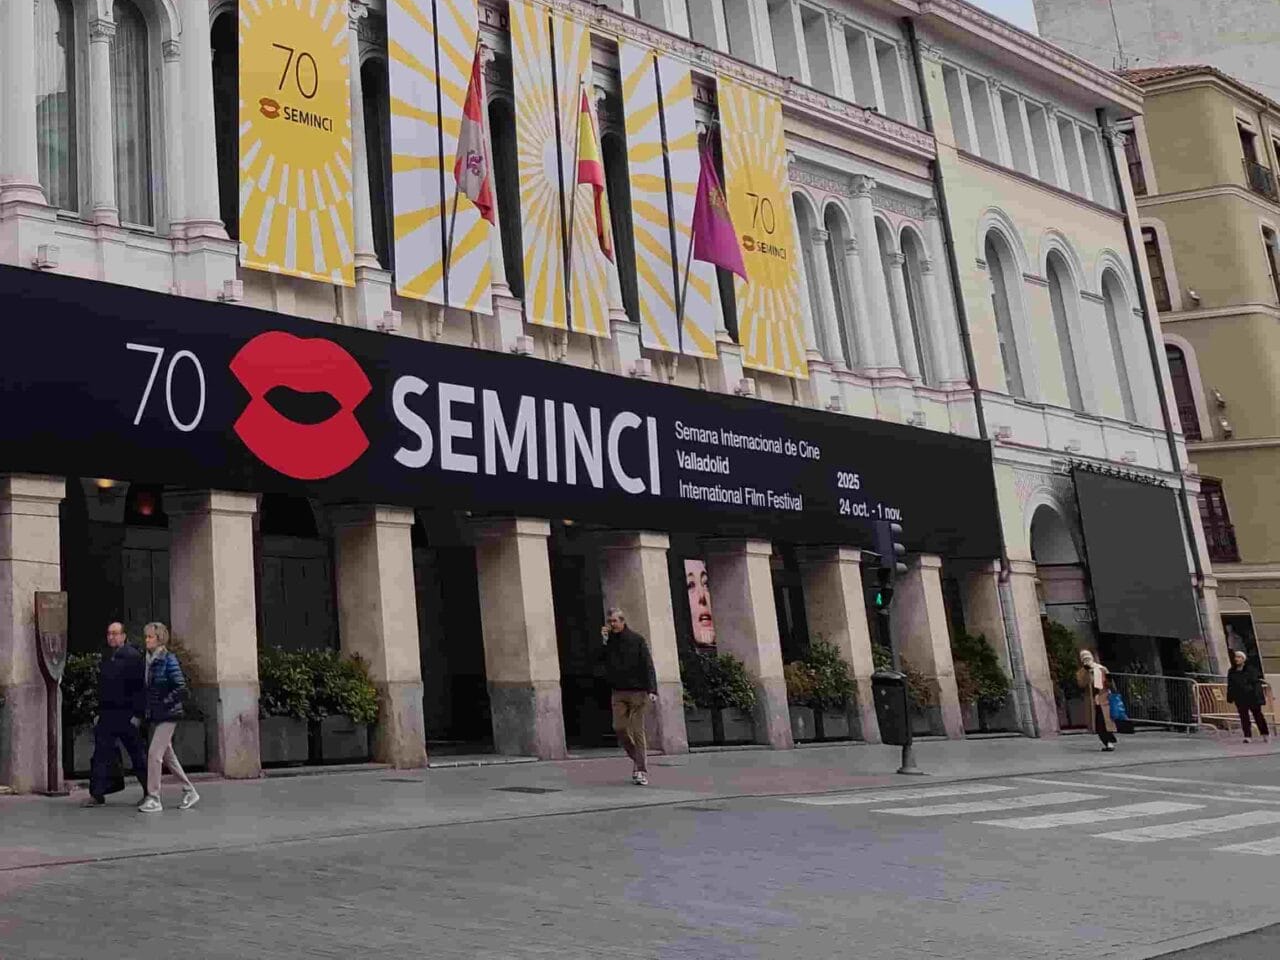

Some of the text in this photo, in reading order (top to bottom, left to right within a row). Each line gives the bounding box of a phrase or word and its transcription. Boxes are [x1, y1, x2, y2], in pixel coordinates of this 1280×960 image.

[272, 42, 318, 99] 70
[283, 106, 333, 133] SEMINCI
[746, 192, 775, 235] 70
[756, 241, 787, 260] SEMINCI
[126, 342, 206, 432] 70
[392, 375, 661, 496] SEMINCI
[675, 421, 820, 460] Semana Internacional de Cine
[677, 449, 730, 474] Valladolid
[679, 480, 803, 511] International Film Festival
[837, 471, 860, 490] 2025
[839, 498, 851, 515] 24
[852, 500, 869, 517] oct.
[885, 506, 902, 521] nov.
